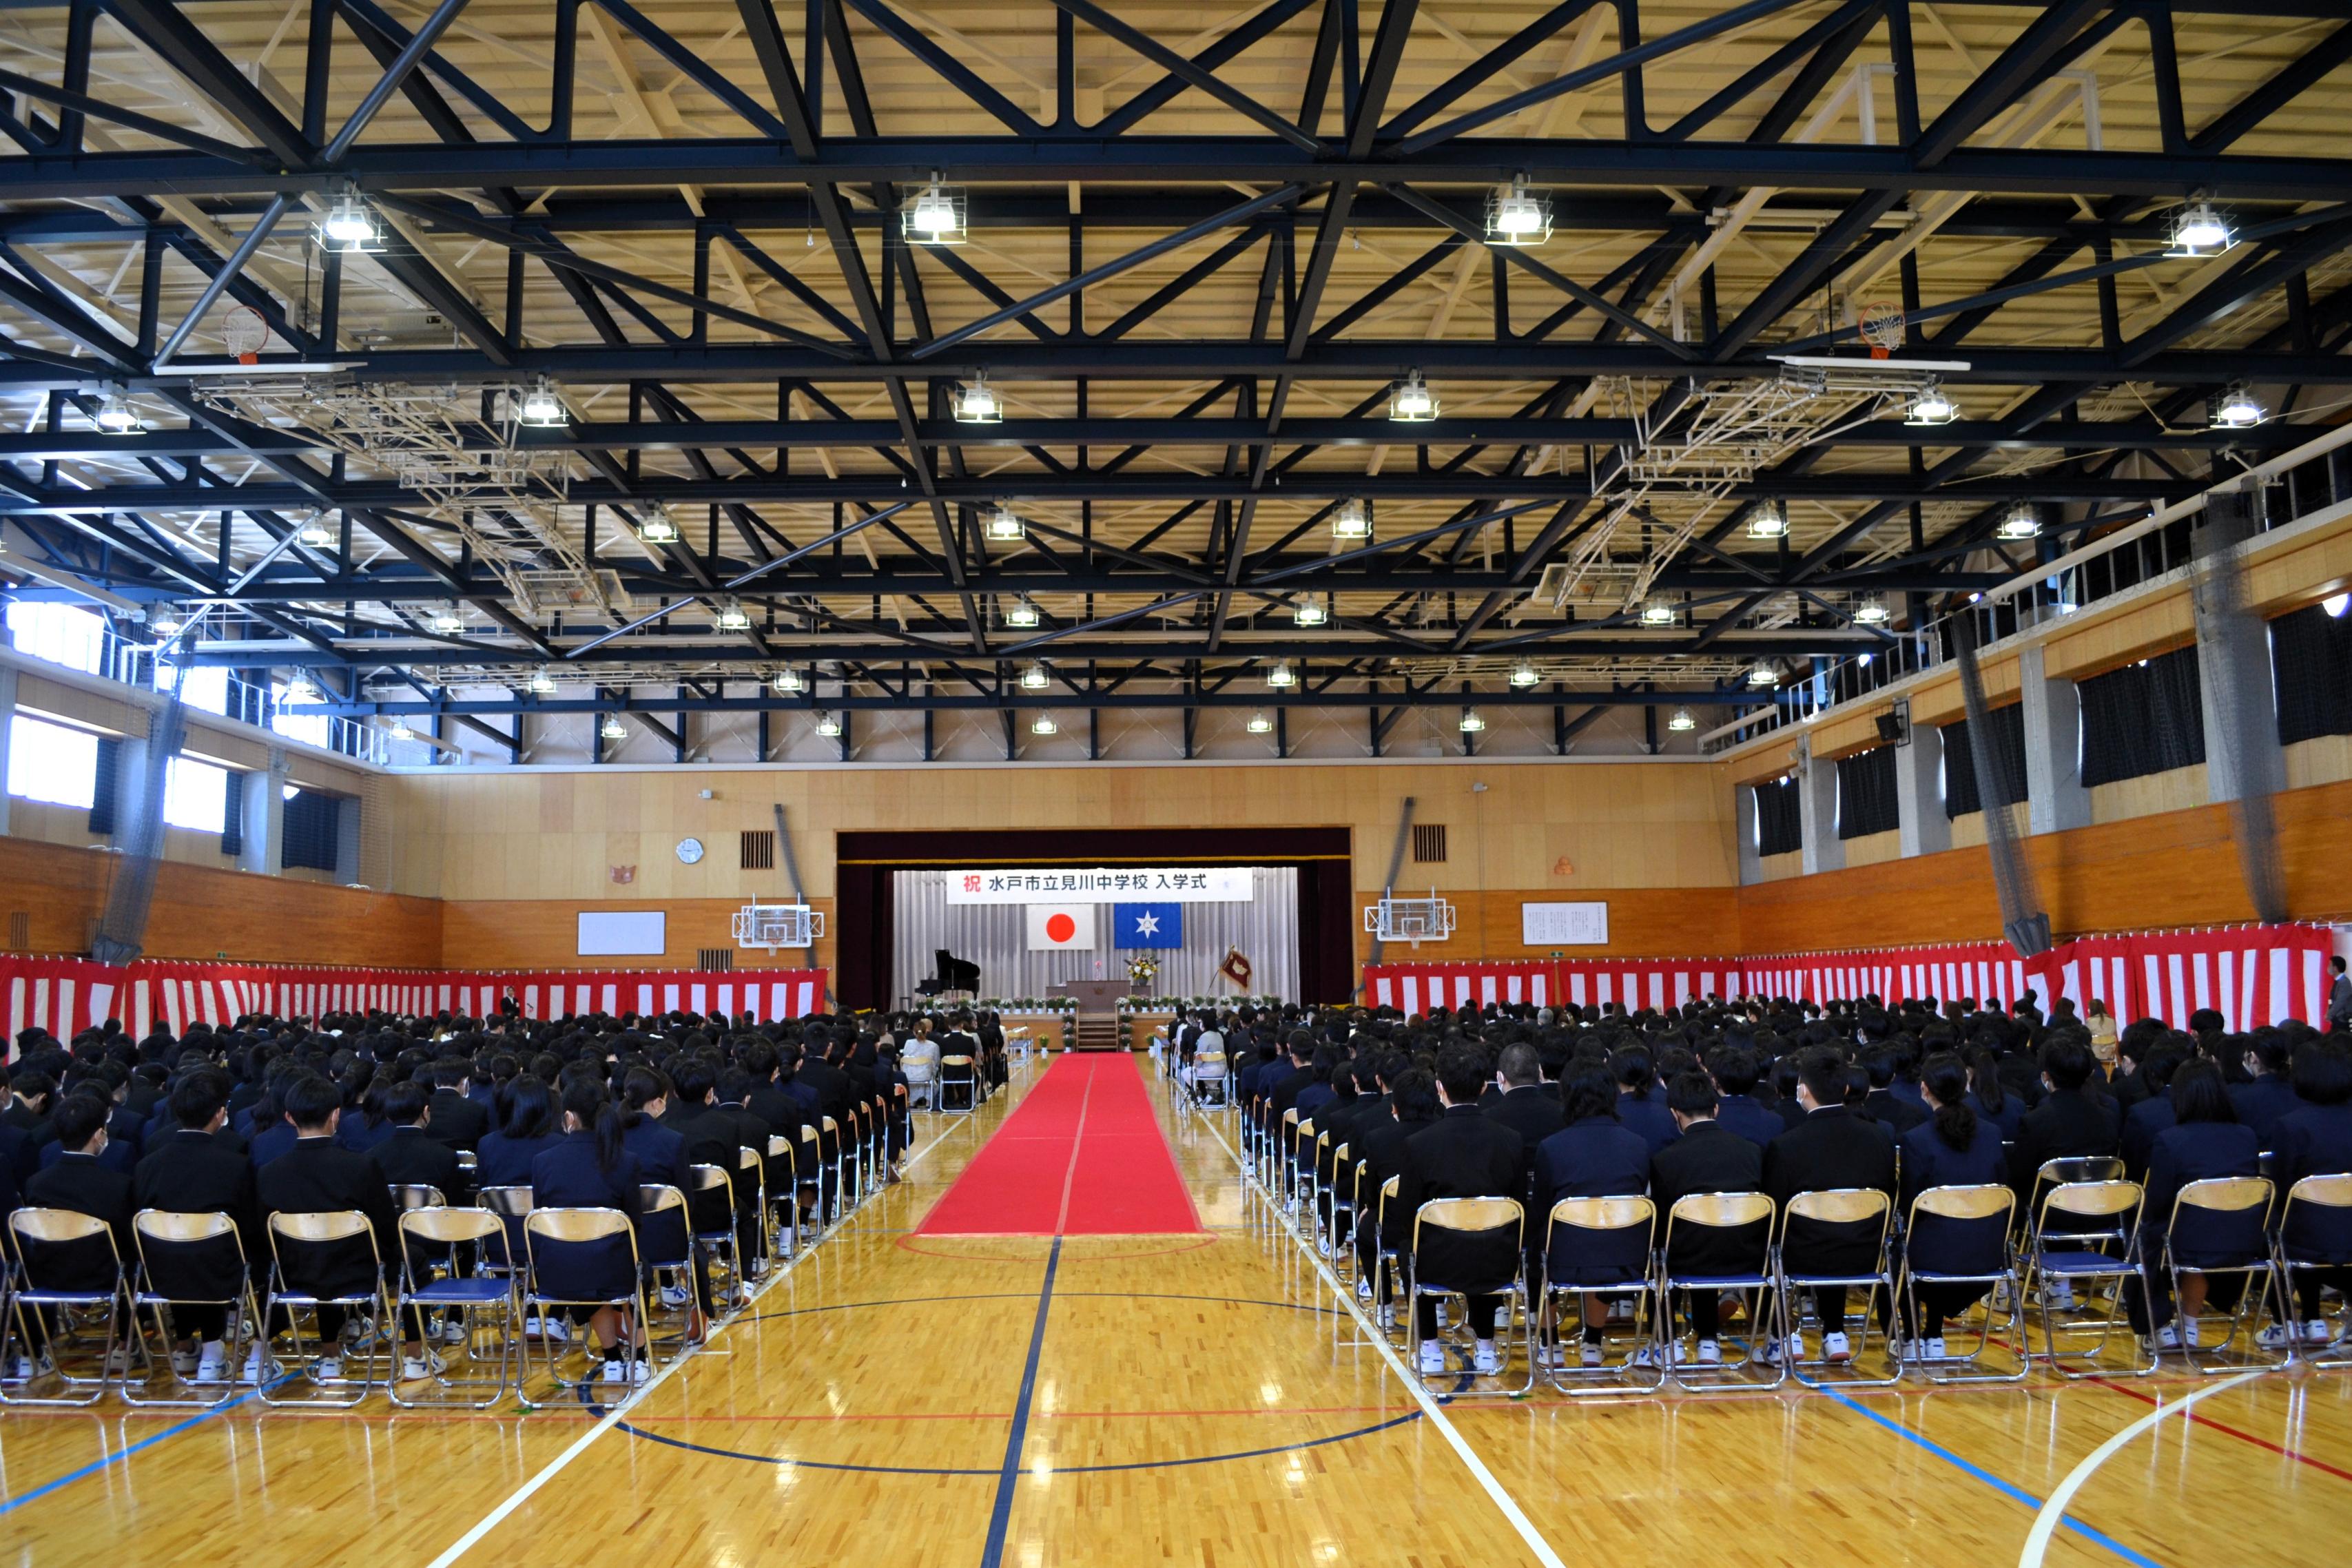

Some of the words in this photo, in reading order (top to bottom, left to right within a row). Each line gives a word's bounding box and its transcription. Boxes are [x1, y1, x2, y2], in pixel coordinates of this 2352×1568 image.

[964, 875, 981, 892] 祝
[989, 874, 1148, 891] 水戸市立見川中学校
[1155, 873, 1207, 889] 入学式
